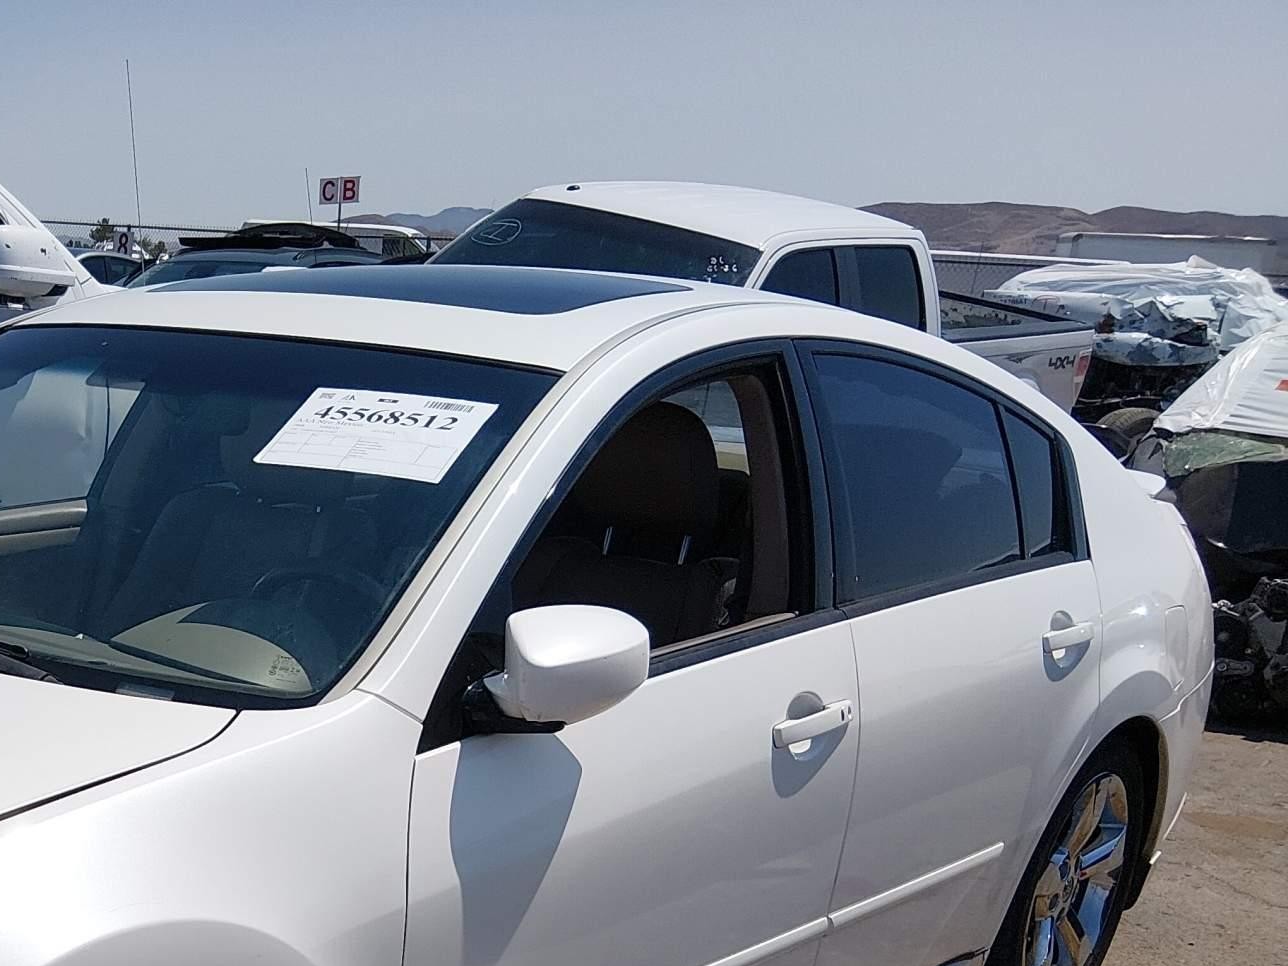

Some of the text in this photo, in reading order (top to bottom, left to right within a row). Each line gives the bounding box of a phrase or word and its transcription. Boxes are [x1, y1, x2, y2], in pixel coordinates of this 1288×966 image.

[322, 179, 356, 201] C B
[314, 405, 459, 431] 45568512
